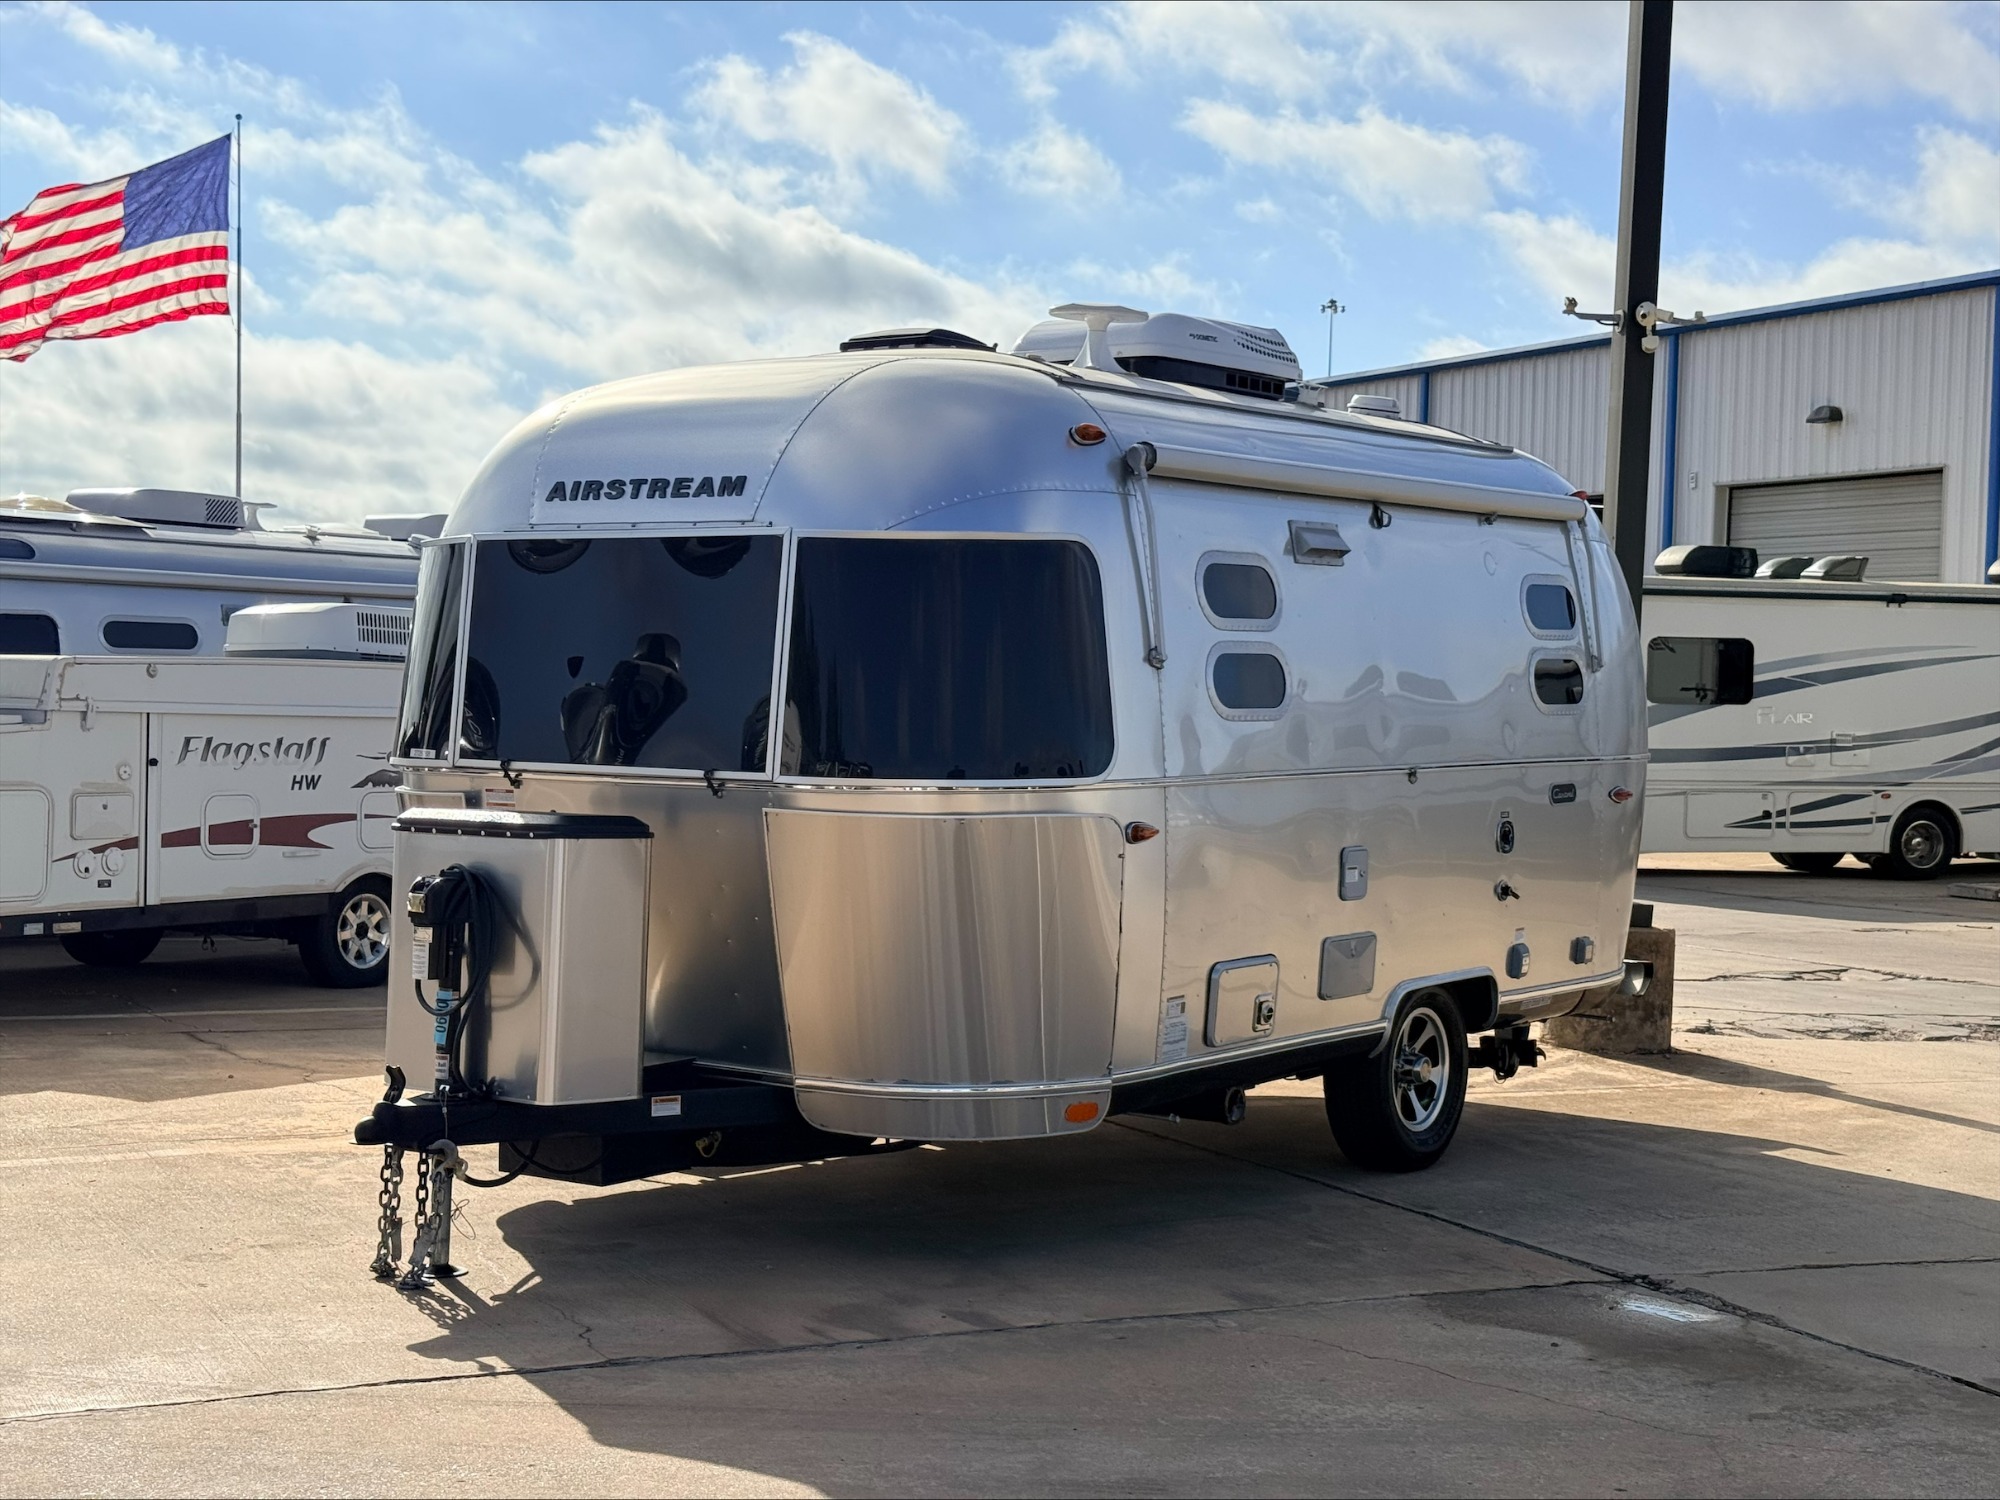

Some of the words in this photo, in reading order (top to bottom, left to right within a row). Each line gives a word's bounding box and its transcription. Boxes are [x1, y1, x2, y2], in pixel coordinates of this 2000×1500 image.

[545, 475, 747, 502] AIRSTREAM
[1757, 706, 1813, 724] FLAIR
[177, 736, 331, 770] Flagstaff
[290, 775, 322, 790] HW
